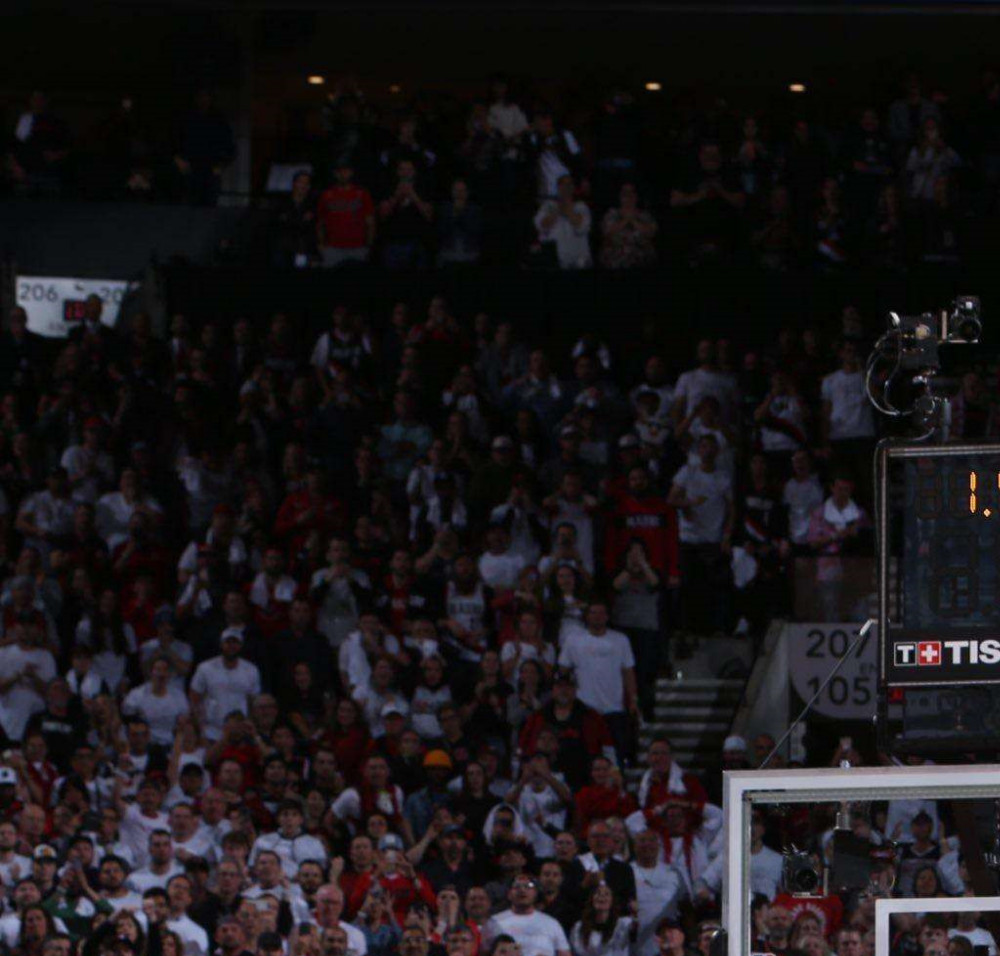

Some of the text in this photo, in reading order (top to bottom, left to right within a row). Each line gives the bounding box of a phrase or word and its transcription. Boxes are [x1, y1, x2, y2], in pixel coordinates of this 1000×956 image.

[20, 284, 58, 301] 206
[806, 629, 870, 659] 207
[807, 676, 871, 705] 105
